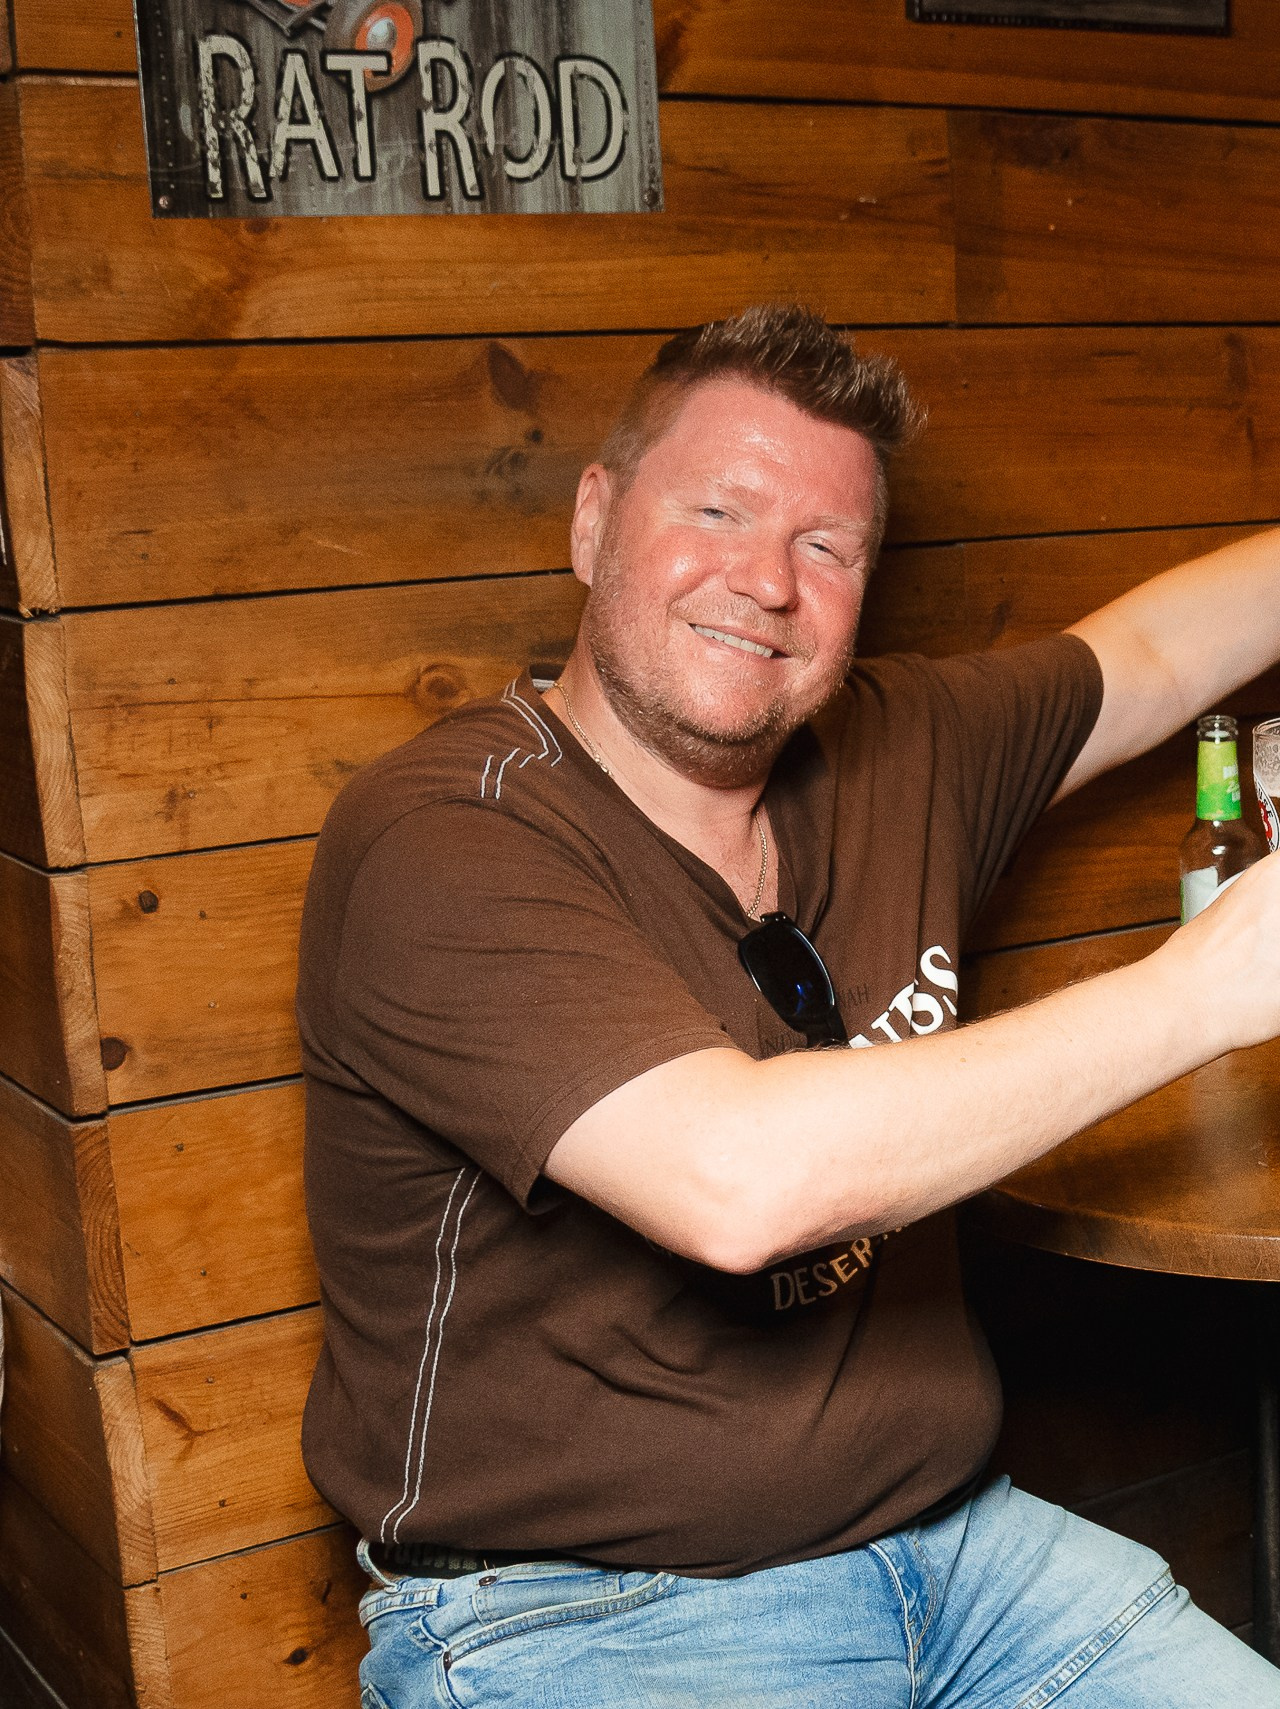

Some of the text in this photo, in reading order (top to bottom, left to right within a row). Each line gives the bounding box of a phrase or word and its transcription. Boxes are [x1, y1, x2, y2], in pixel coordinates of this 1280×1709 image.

[200, 33, 628, 199] RAT ROD
[769, 1235, 892, 1312] DESER
